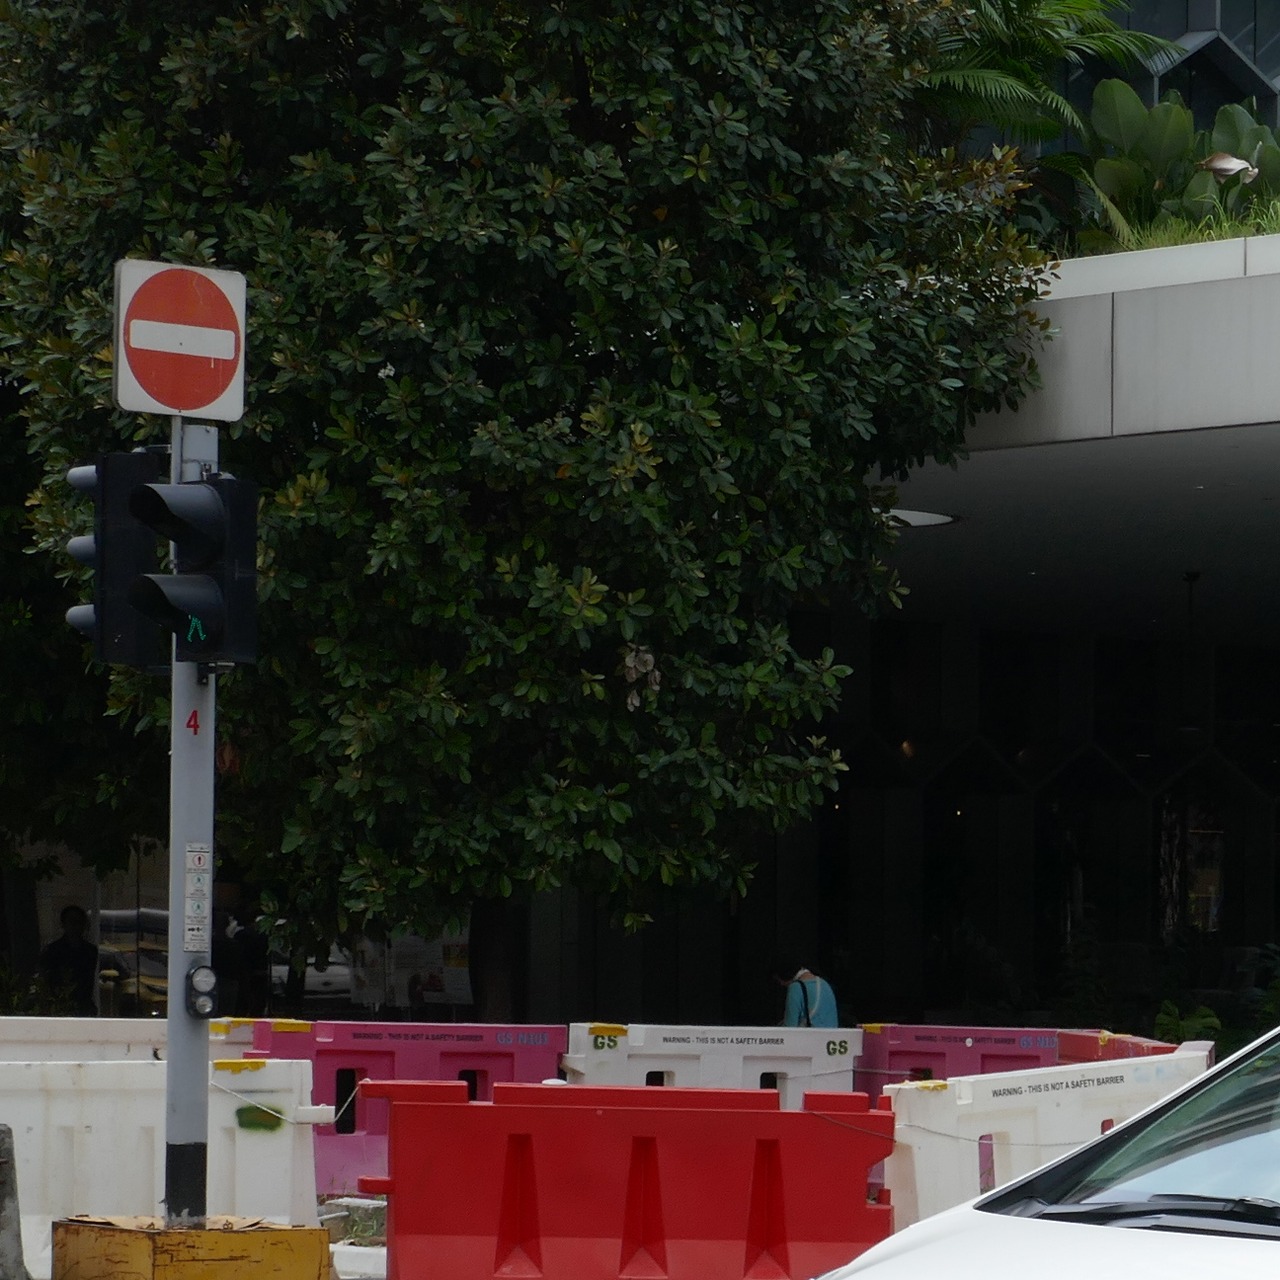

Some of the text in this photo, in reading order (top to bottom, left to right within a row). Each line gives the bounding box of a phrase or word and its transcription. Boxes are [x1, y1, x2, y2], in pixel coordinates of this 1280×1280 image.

[186, 709, 200, 736] 4
[593, 1035, 618, 1050] GS
[663, 1036, 691, 1044] WARNING
[717, 1037, 729, 1045] NOT
[729, 1037, 735, 1045] A
[735, 1037, 758, 1045] SAFETY
[759, 1037, 785, 1045] BARRIER
[826, 1040, 849, 1056] GS
[991, 1086, 1023, 1098] WARNING
[1028, 1084, 1042, 1094] THIS
[1043, 1083, 1050, 1092] IS
[1051, 1081, 1064, 1091] NOT
[1065, 1081, 1071, 1090] A
[1071, 1078, 1095, 1090] SAFETY
[1096, 1075, 1125, 1087] BARRIER
